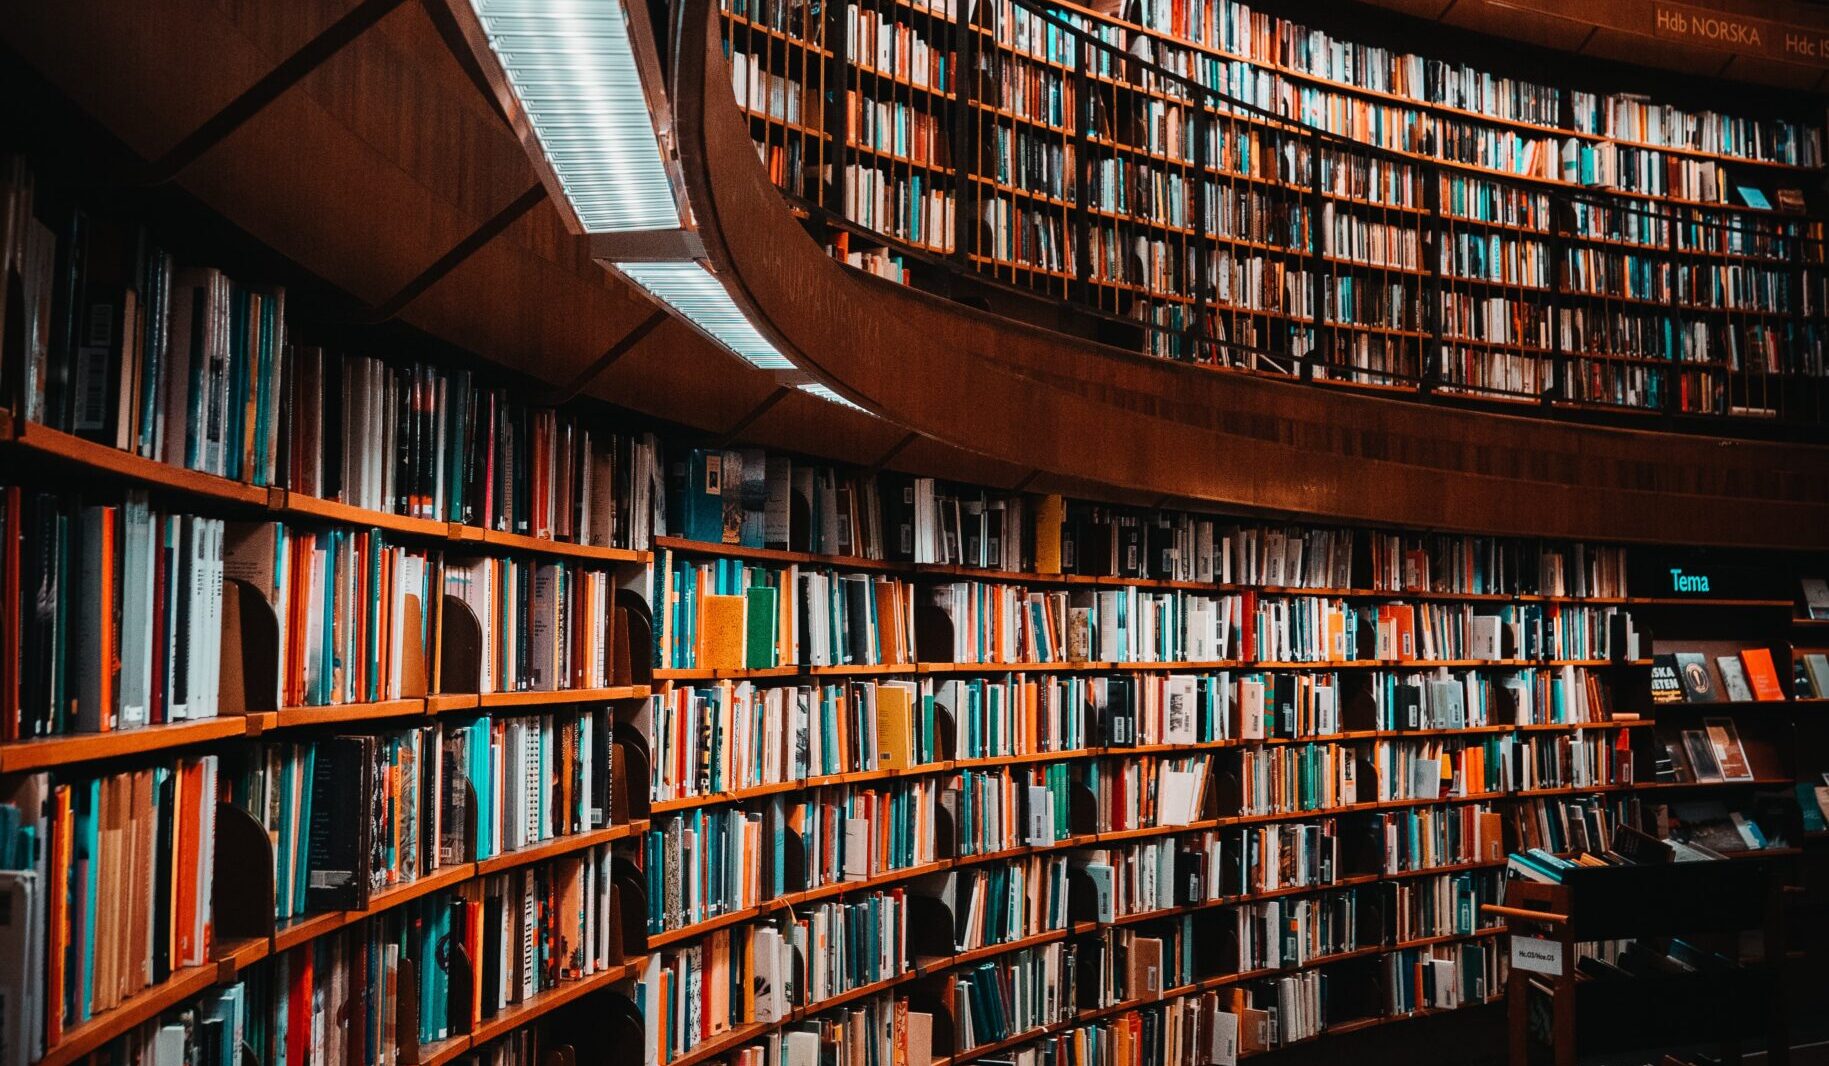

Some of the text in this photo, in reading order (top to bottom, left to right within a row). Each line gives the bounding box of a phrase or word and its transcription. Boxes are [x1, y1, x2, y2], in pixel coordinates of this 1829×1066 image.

[1657, 9, 1761, 47] Hdb NORSKA
[1785, 33, 1816, 56] Hdc
[1670, 569, 1710, 592] Tema
[1651, 666, 1676, 678] SKA
[524, 890, 532, 920] TRE
